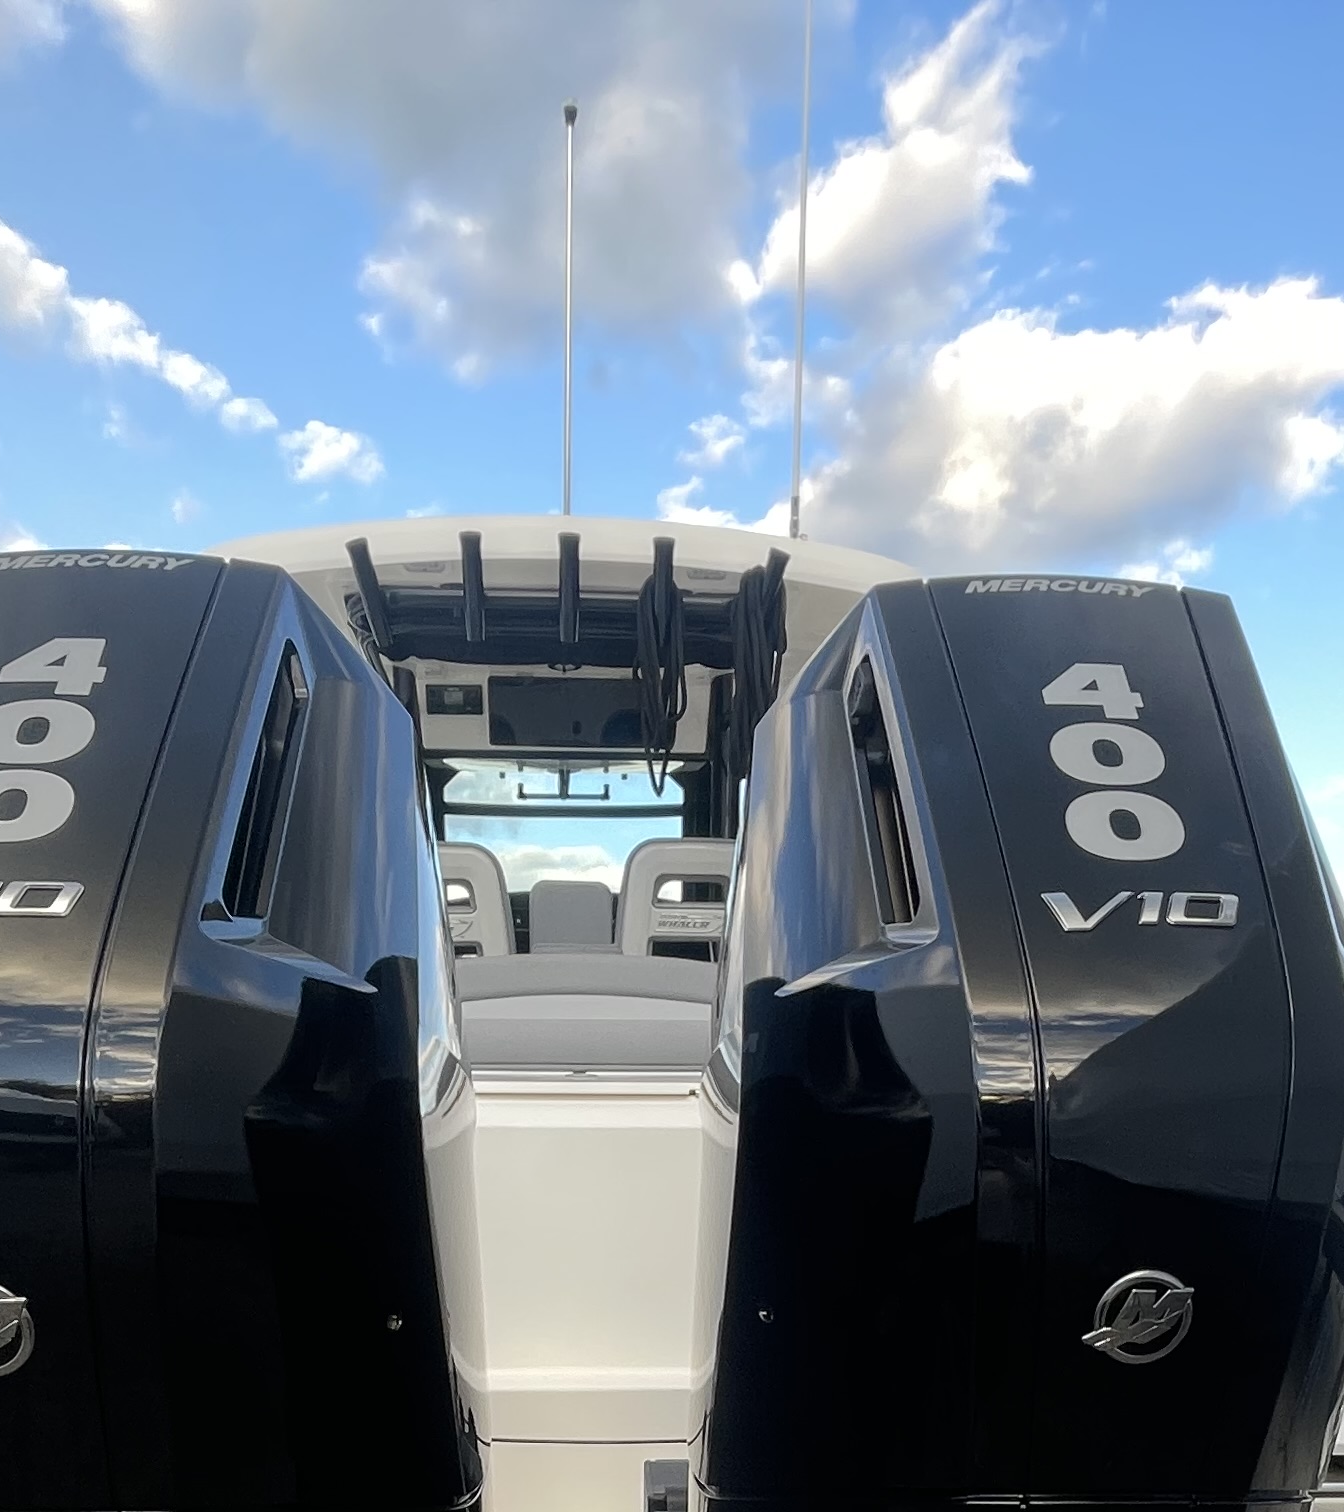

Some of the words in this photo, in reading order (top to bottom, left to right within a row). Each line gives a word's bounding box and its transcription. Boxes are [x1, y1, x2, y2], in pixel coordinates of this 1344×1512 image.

[964, 578, 1154, 598] MERCURY
[1041, 662, 1186, 862] 400
[1040, 890, 1240, 932] V10
